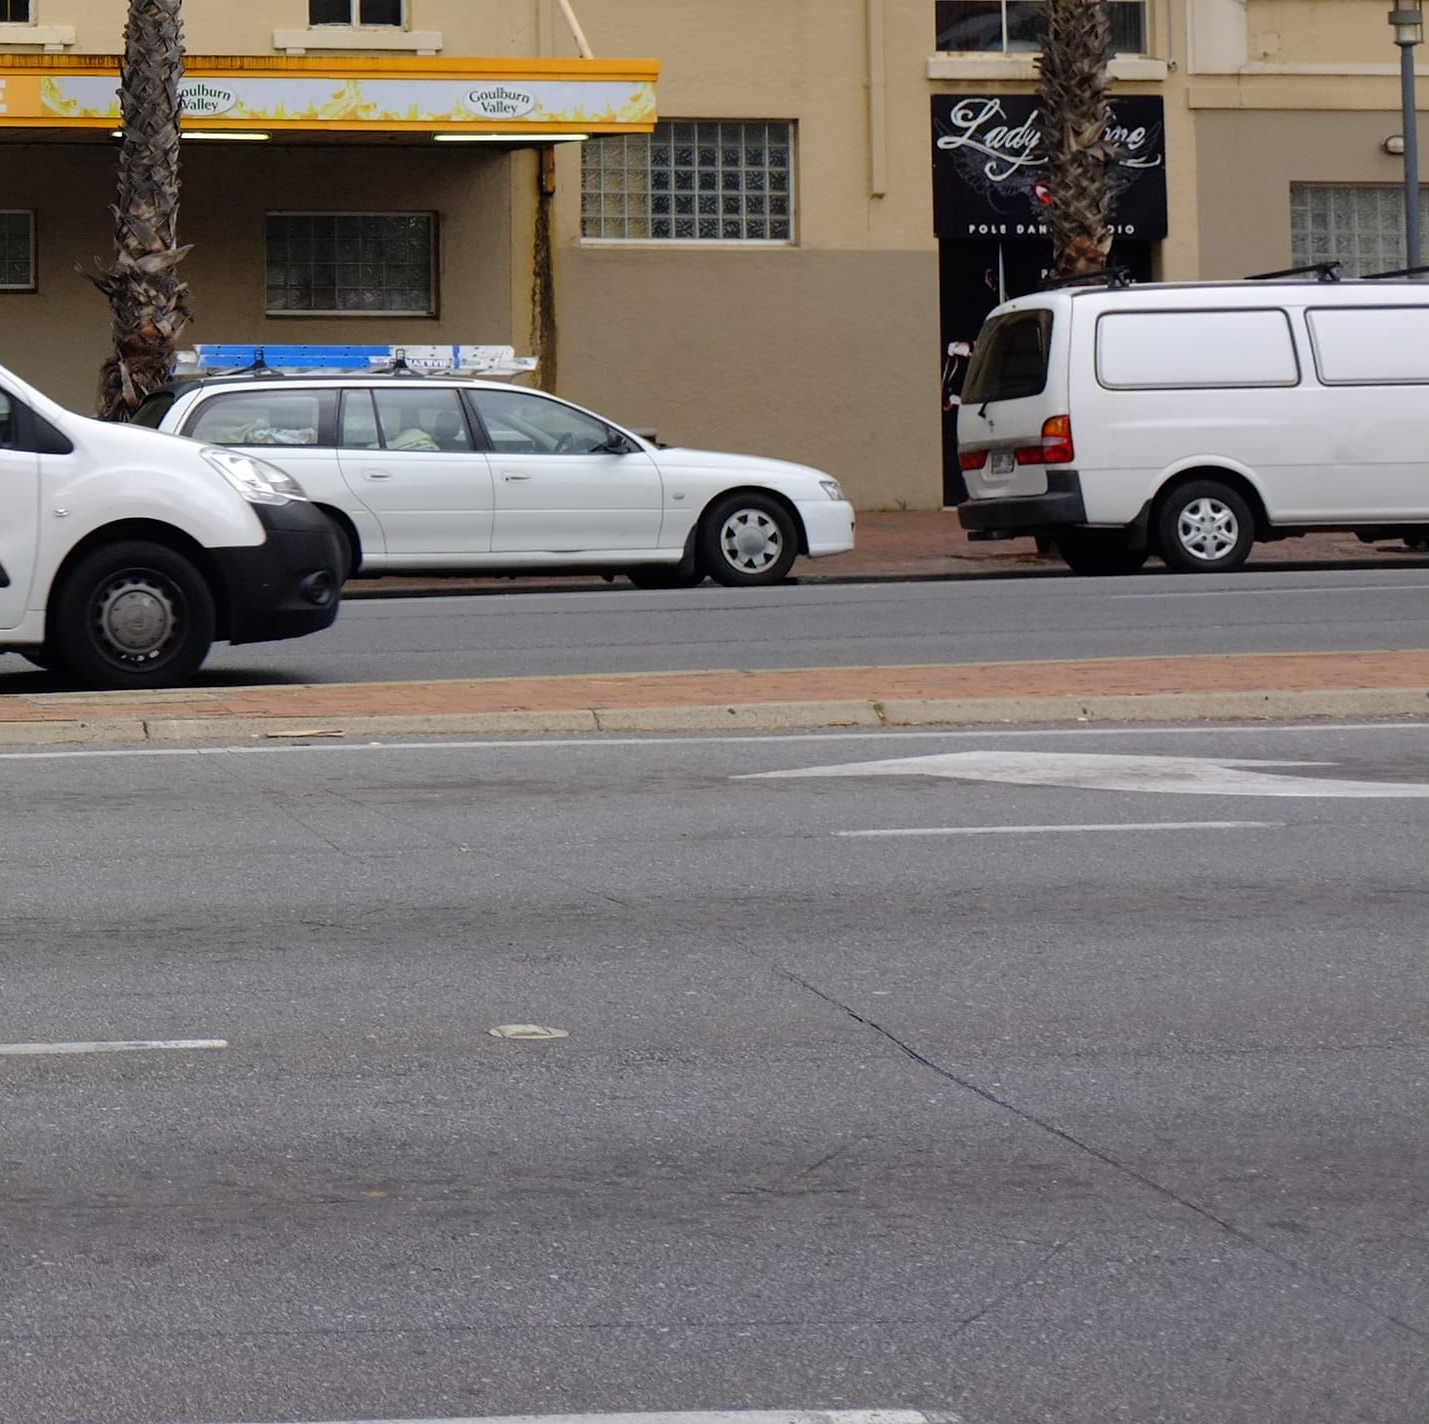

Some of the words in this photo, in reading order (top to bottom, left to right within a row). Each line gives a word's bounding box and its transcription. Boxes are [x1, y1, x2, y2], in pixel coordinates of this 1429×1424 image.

[179, 83, 232, 102] oulburn
[469, 87, 530, 104] Goulburn
[481, 101, 518, 117] Valley
[937, 97, 1049, 182] Lady
[969, 224, 1007, 234] POLE
